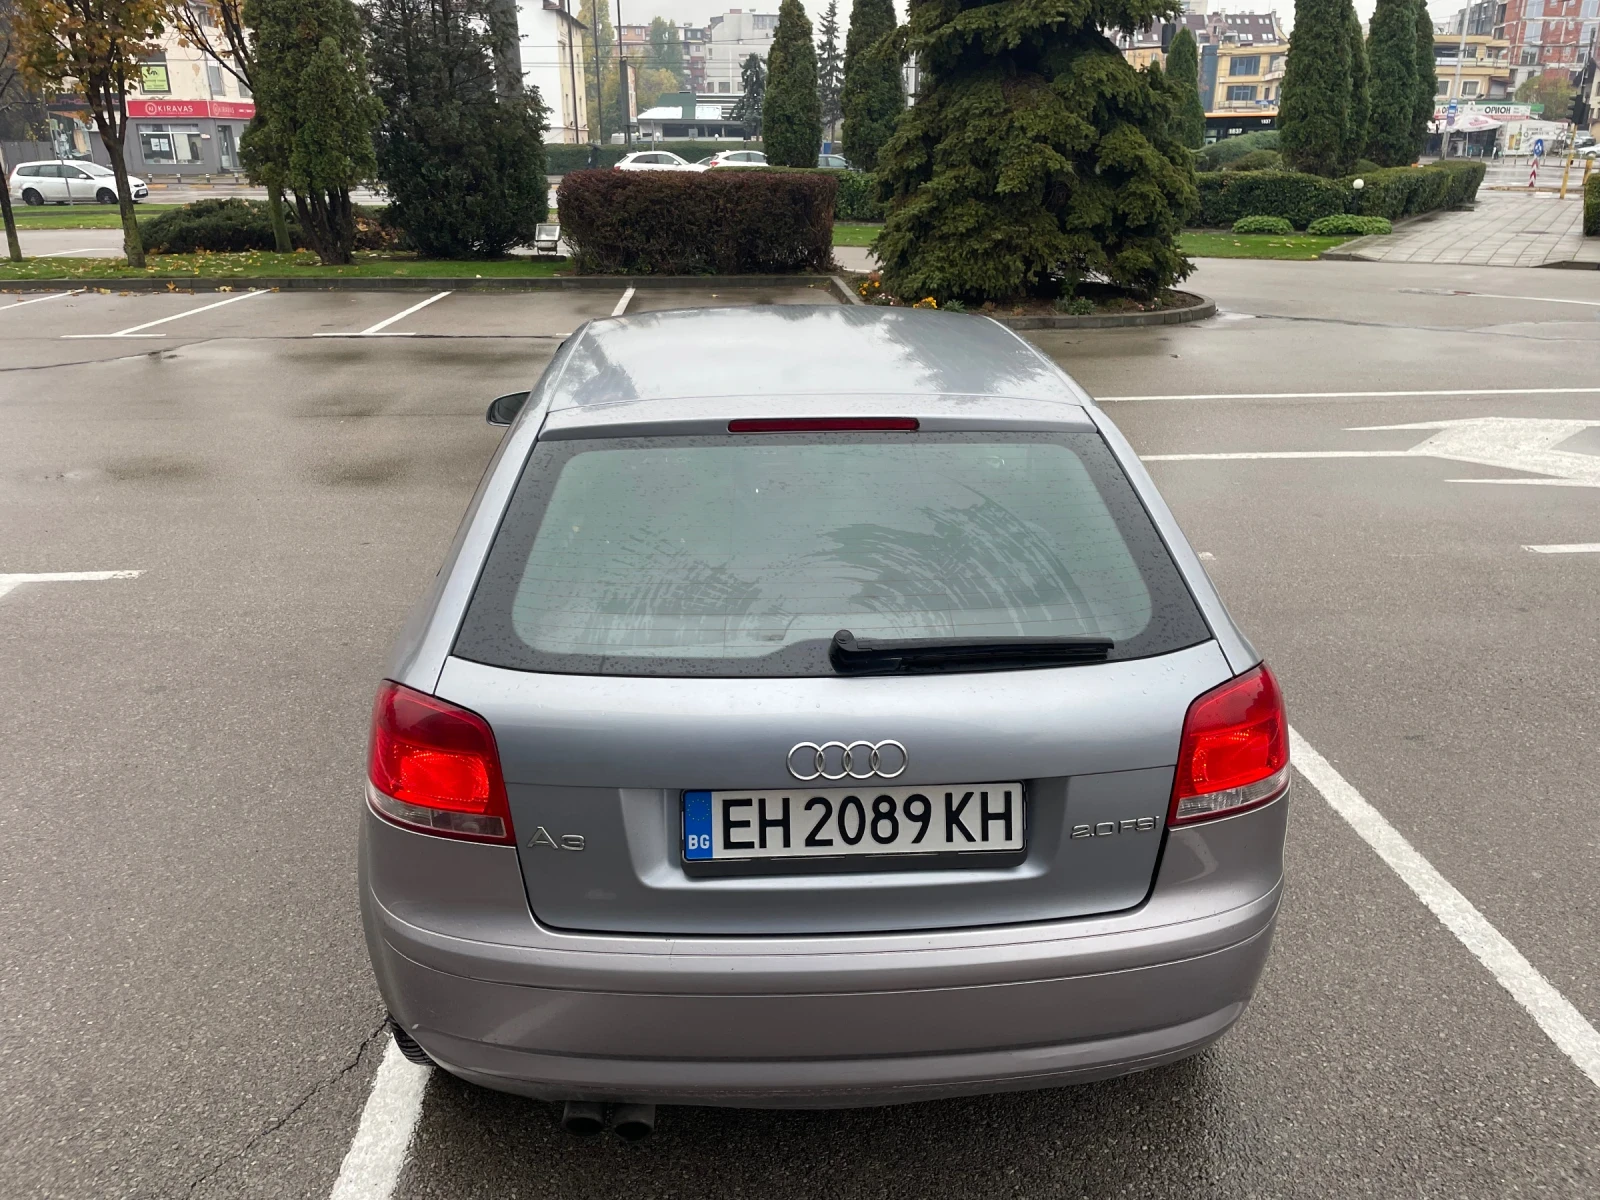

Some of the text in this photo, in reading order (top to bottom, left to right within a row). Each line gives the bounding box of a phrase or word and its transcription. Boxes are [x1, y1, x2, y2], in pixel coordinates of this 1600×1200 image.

[157, 105, 194, 113] KIRAVAS
[1484, 106, 1511, 114] ОРИОН
[722, 790, 1013, 850] EH 2089 KH
[527, 826, 585, 851] A3
[1071, 824, 1115, 839] 2.0
[688, 834, 710, 850] BG
